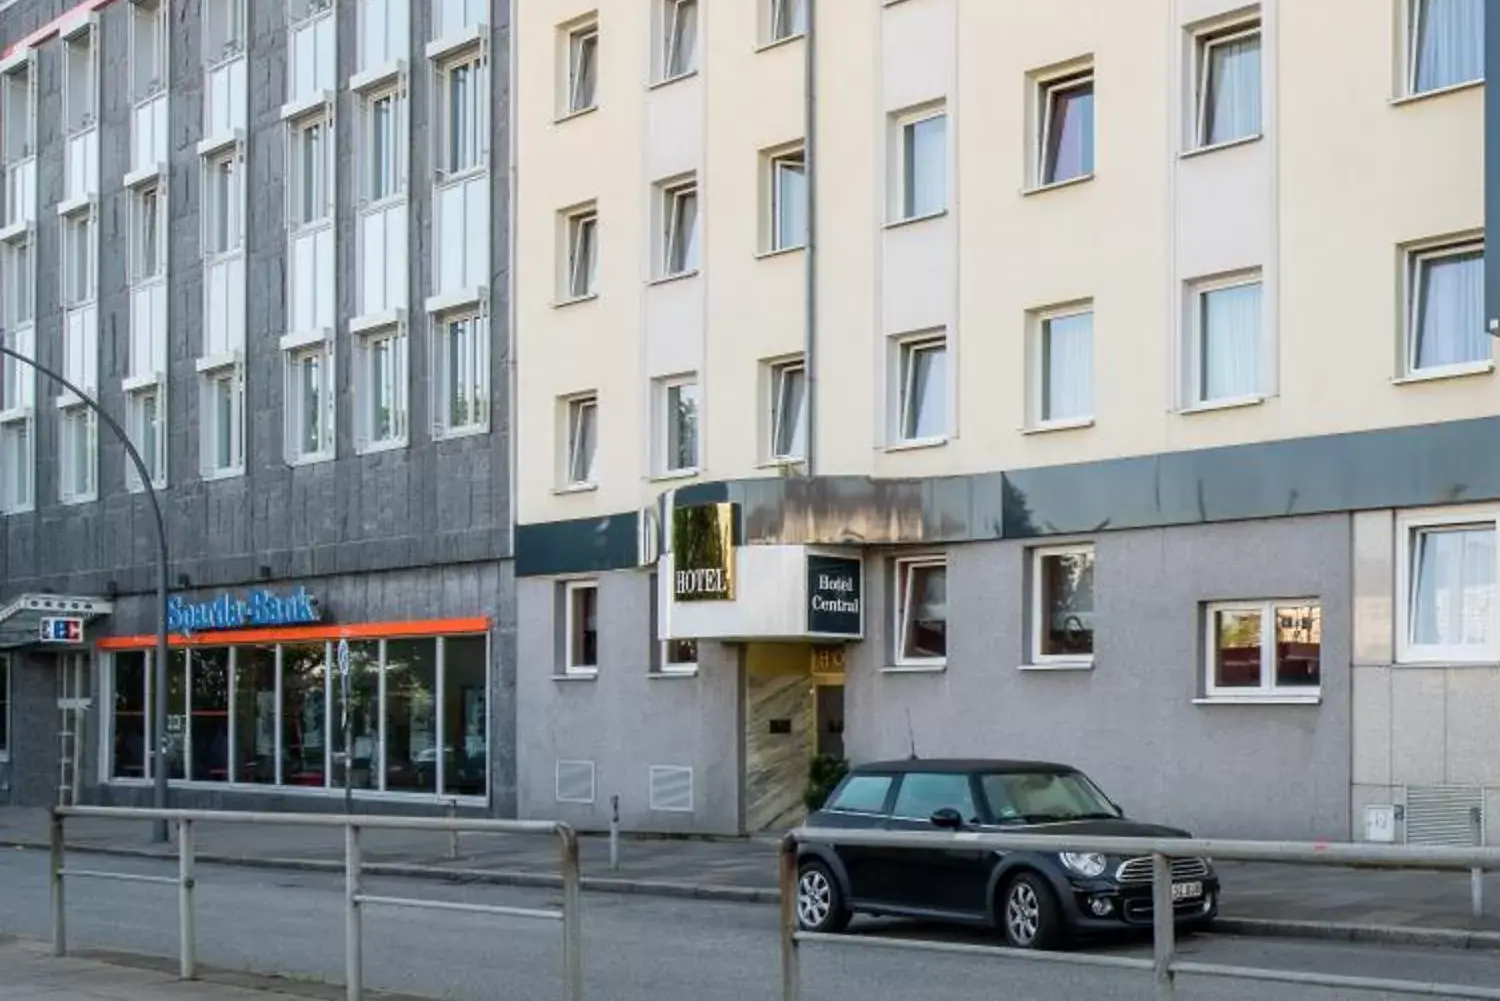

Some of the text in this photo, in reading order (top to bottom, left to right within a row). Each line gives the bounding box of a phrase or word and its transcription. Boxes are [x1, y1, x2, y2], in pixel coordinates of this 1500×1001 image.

[676, 567, 727, 594] HOTEL
[819, 574, 854, 593] Hotel
[167, 585, 320, 639] Sparda-Bank
[811, 594, 859, 614] Central
